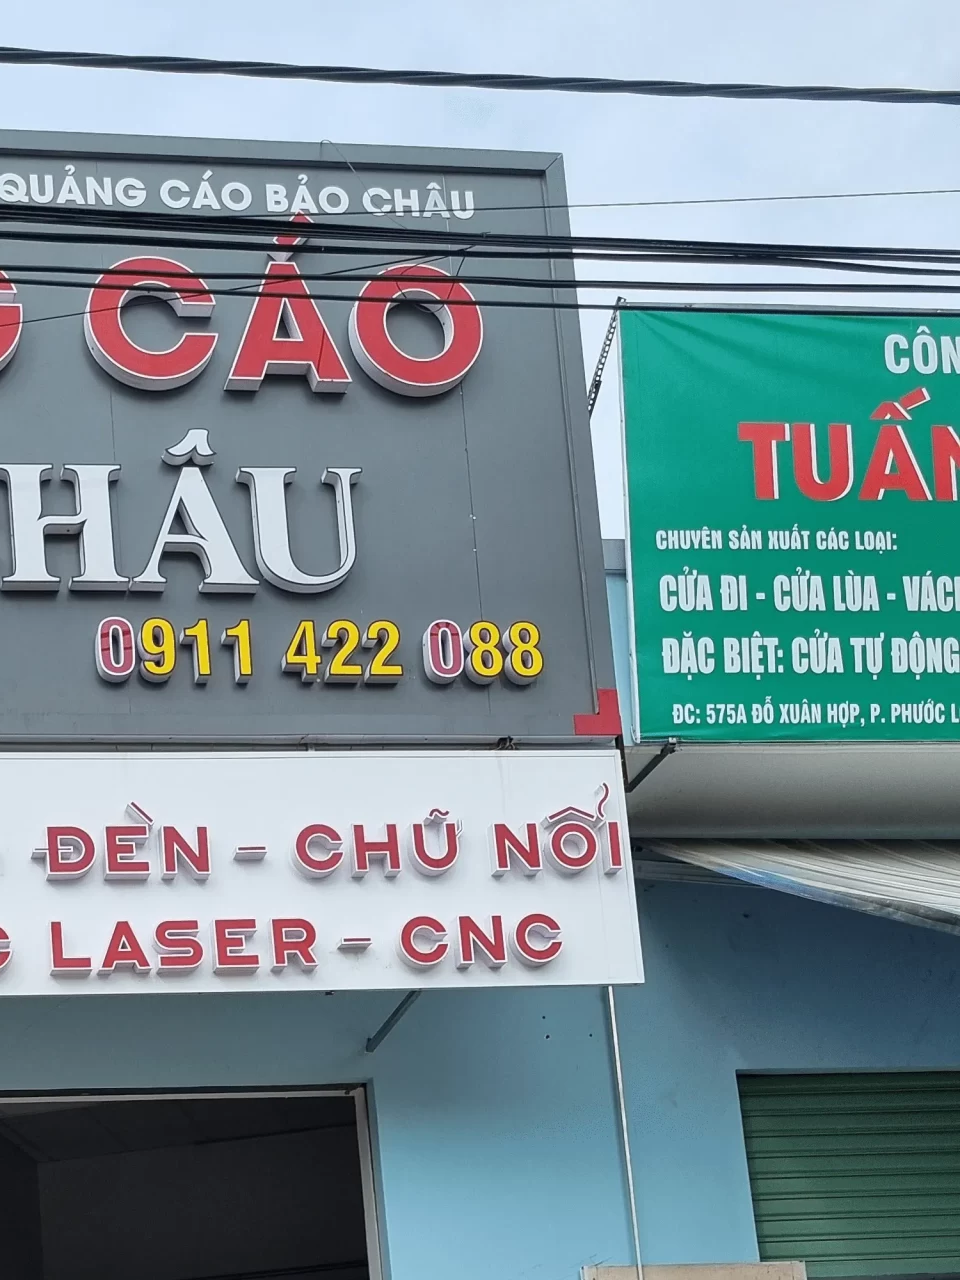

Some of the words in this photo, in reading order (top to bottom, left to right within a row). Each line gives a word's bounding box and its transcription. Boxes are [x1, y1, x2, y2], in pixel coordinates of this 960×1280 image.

[159, 170, 254, 212] CÁO
[265, 174, 350, 215] BẢO
[361, 181, 477, 220] CHÂU
[84, 212, 485, 397] CÁO
[655, 526, 723, 550] CHUYÊN
[729, 525, 763, 550] SẢN
[768, 524, 810, 550] XUẤT
[816, 525, 850, 552] CÁC
[855, 529, 898, 556] LOẠI:
[659, 566, 714, 612] CỬA
[720, 575, 749, 612] ĐI
[755, 592, 766, 600] -
[773, 566, 827, 612] CỬA
[832, 569, 880, 612] LÙA
[886, 592, 896, 601] -
[95, 616, 254, 686] 0911
[281, 620, 404, 686] 422
[422, 618, 545, 686] 088
[661, 630, 716, 681] ĐẶC
[723, 630, 785, 681] BIỆT:
[791, 628, 845, 675] CỬA
[850, 631, 885, 681] TỰ
[891, 630, 960, 681] ĐỘNG
[672, 703, 701, 725] ĐC:
[706, 703, 747, 725] 575A
[751, 695, 775, 725] ĐỖ
[779, 698, 822, 725] XUÂN
[826, 700, 865, 728] HỢP,
[870, 703, 886, 724] P.
[890, 698, 946, 724] PHƯỚC
[30, 801, 213, 881] ĐÈN
[292, 808, 464, 879] CHỮ
[491, 782, 624, 877] NỔI
[49, 917, 318, 977] LASER
[398, 913, 564, 969] CNC
